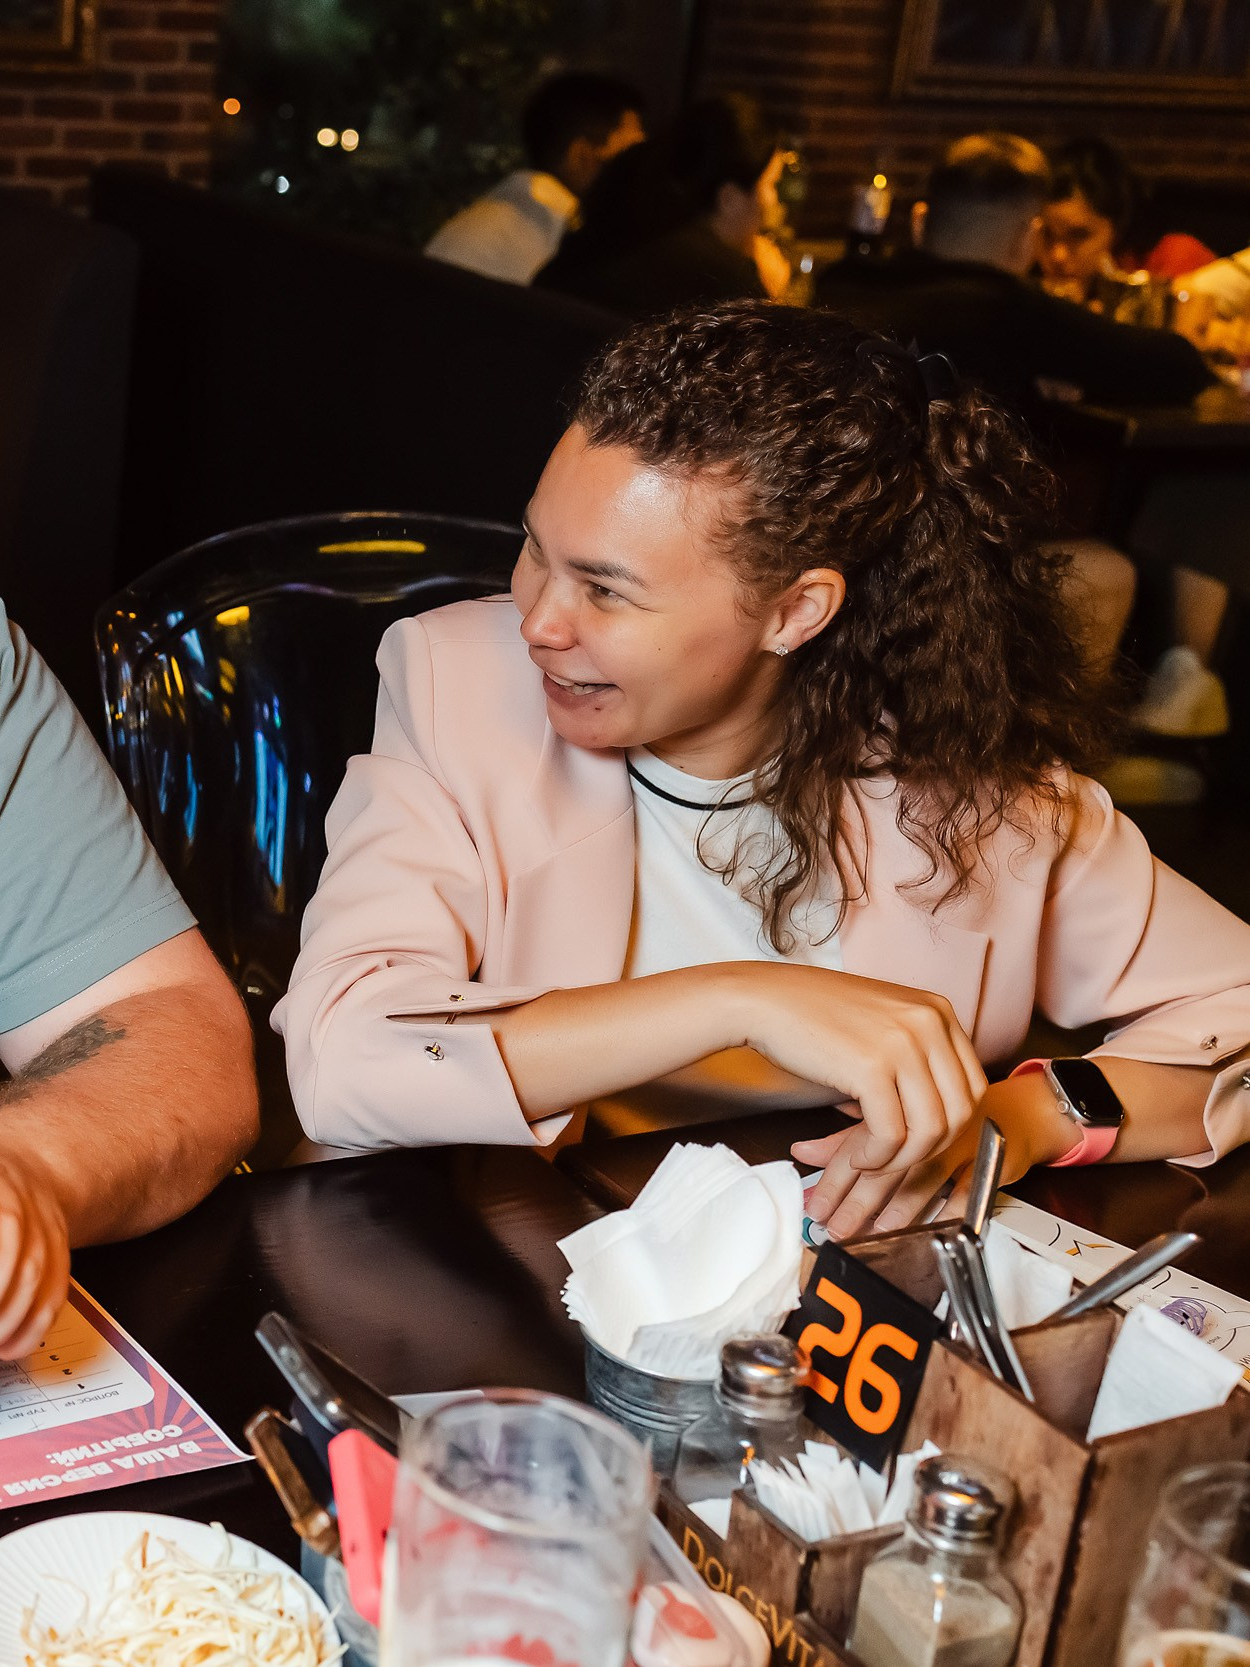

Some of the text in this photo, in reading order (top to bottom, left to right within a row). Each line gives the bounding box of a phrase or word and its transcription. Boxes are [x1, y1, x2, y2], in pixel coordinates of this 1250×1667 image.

[62, 1368, 72, 1376] 2
[797, 1277, 918, 1434] 26
[78, 1390, 120, 1405] ВОПРОС
[2, 1440, 202, 1497] ВАША ВЕРСИЯ
[45, 1424, 183, 1467] СОБЫТИЙ:
[684, 1526, 826, 1667] DOLCEVIT
